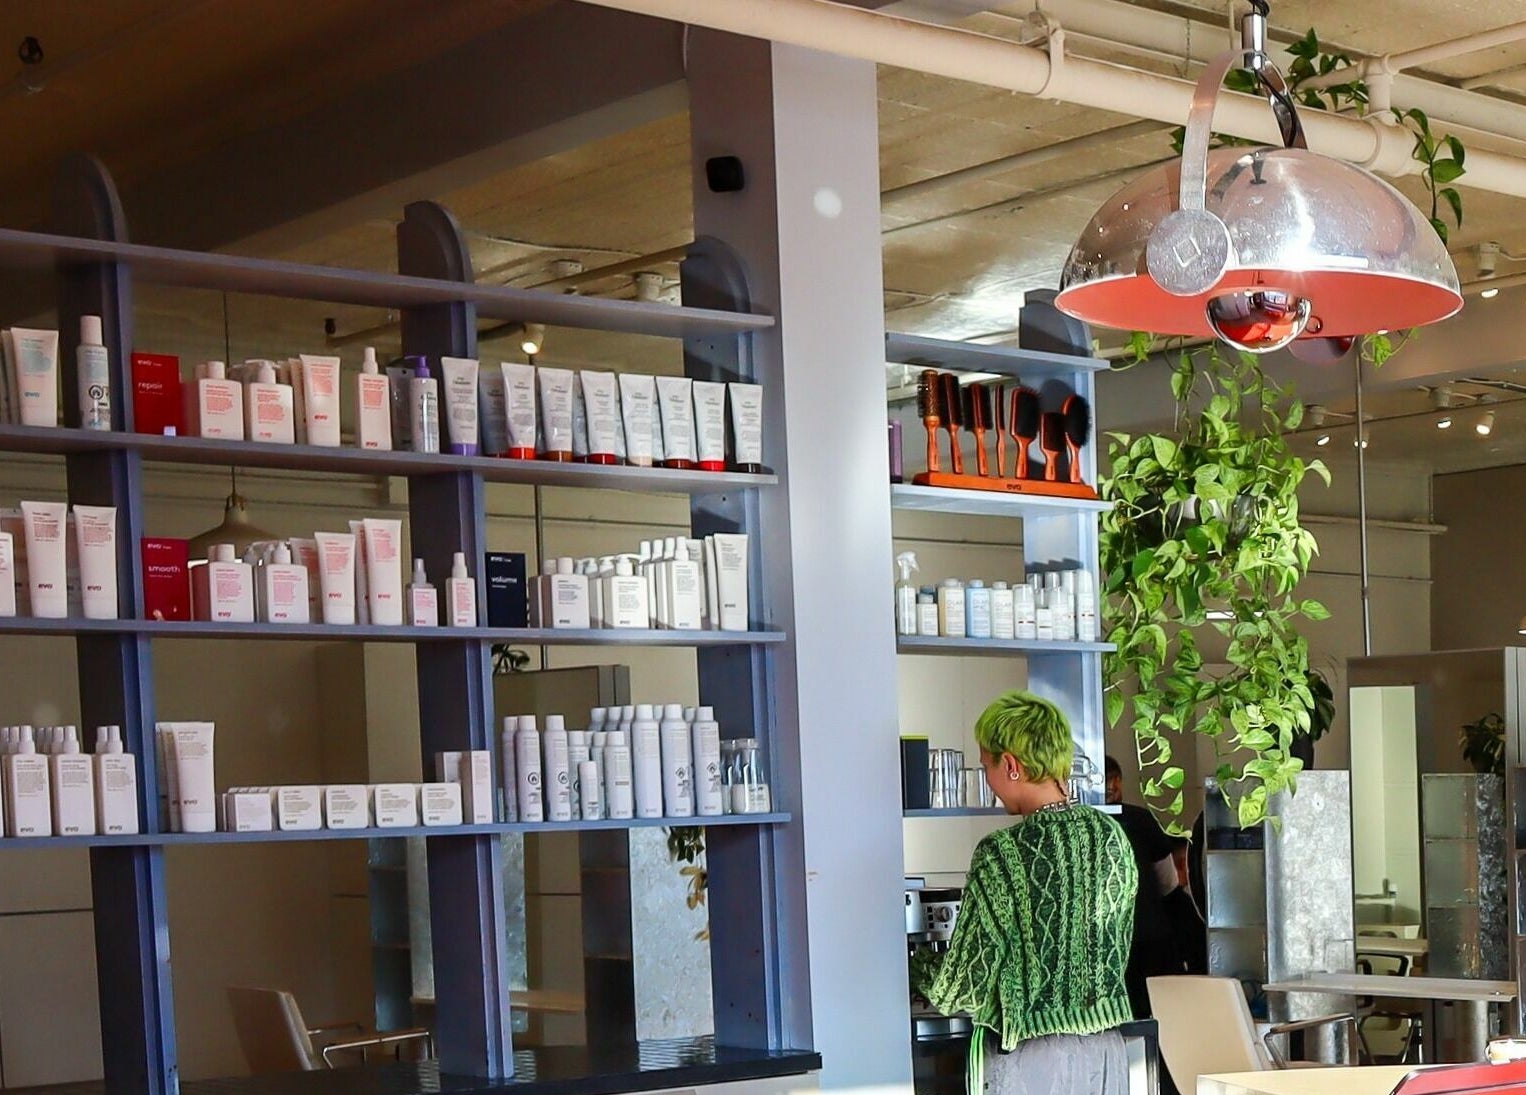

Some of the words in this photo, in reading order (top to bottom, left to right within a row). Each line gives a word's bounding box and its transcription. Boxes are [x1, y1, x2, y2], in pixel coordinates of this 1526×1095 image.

[138, 382, 163, 391] repair
[1007, 483, 1021, 491] evo
[148, 565, 180, 574] smooth
[491, 575, 517, 584] volume
[274, 611, 288, 619] evo
